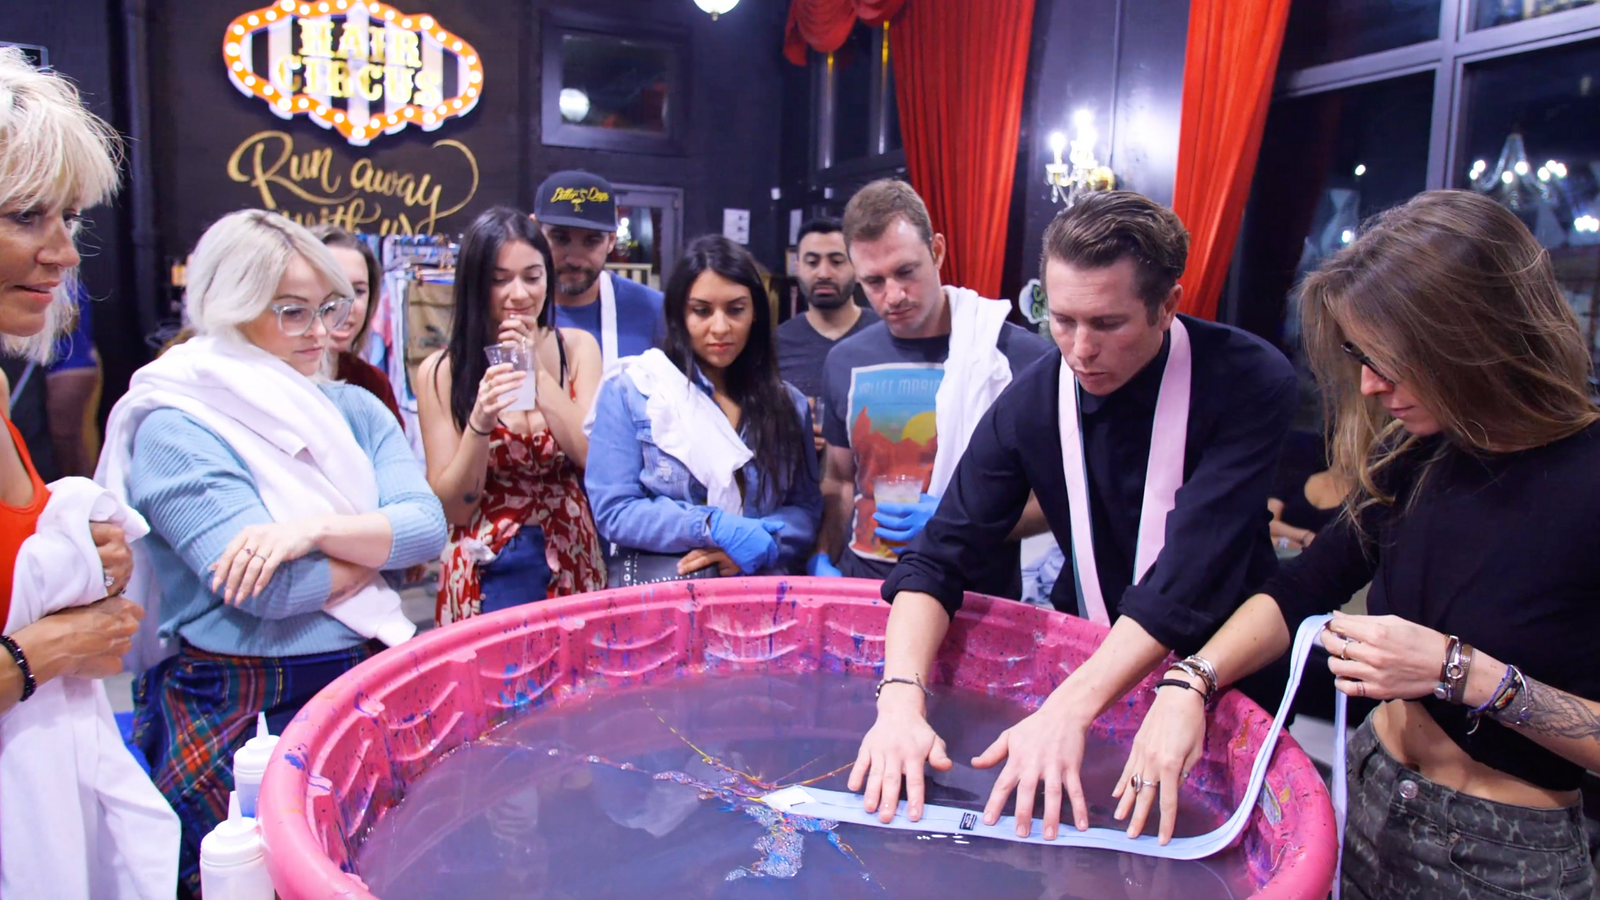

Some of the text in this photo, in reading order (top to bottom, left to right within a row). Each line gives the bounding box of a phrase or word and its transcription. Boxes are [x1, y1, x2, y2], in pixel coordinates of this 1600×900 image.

[298, 18, 422, 68] HAIR
[277, 54, 443, 106] CIRCUS
[227, 130, 479, 235] Run away
